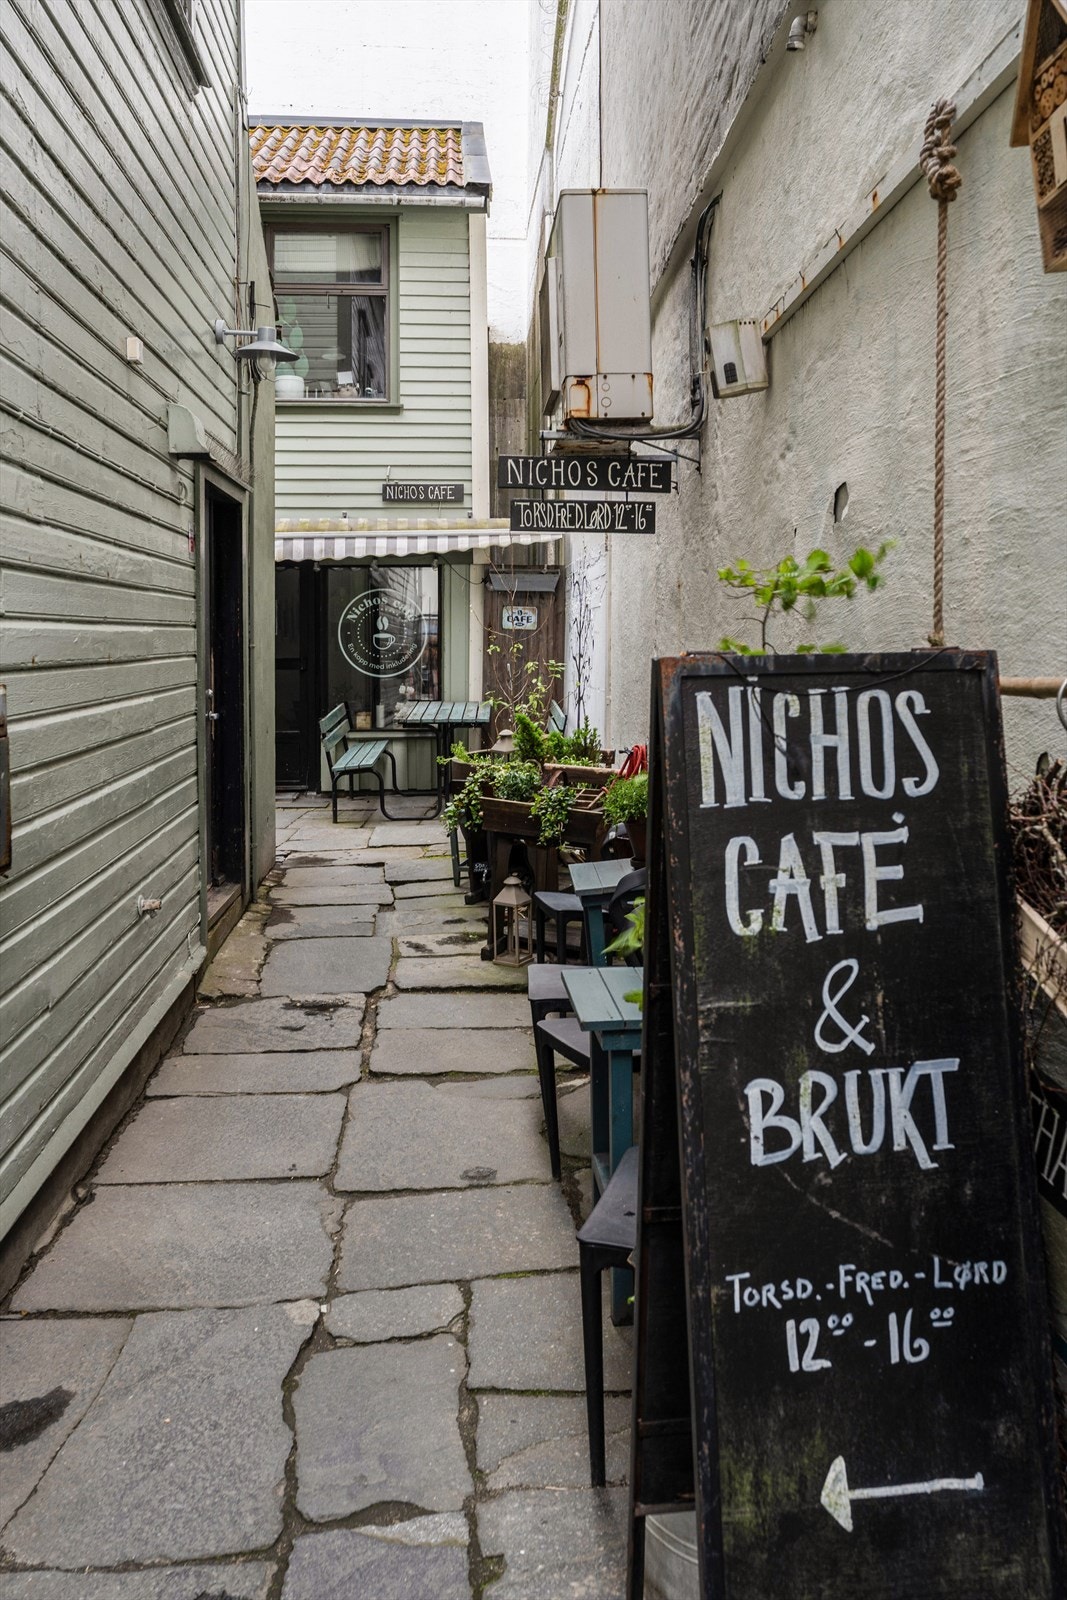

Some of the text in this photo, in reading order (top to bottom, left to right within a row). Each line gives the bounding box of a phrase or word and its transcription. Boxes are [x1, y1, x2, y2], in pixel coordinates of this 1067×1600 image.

[507, 459, 663, 489] NICHOS CAFE
[386, 485, 455, 500] NICHOS CAFE
[346, 597, 388, 623] Nichos
[506, 615, 533, 624] CAFE
[347, 643, 355, 653] En
[353, 651, 369, 666] kopp
[695, 676, 940, 809] NICHOS
[814, 958, 875, 1056] &
[744, 1057, 960, 1170] BRUKT
